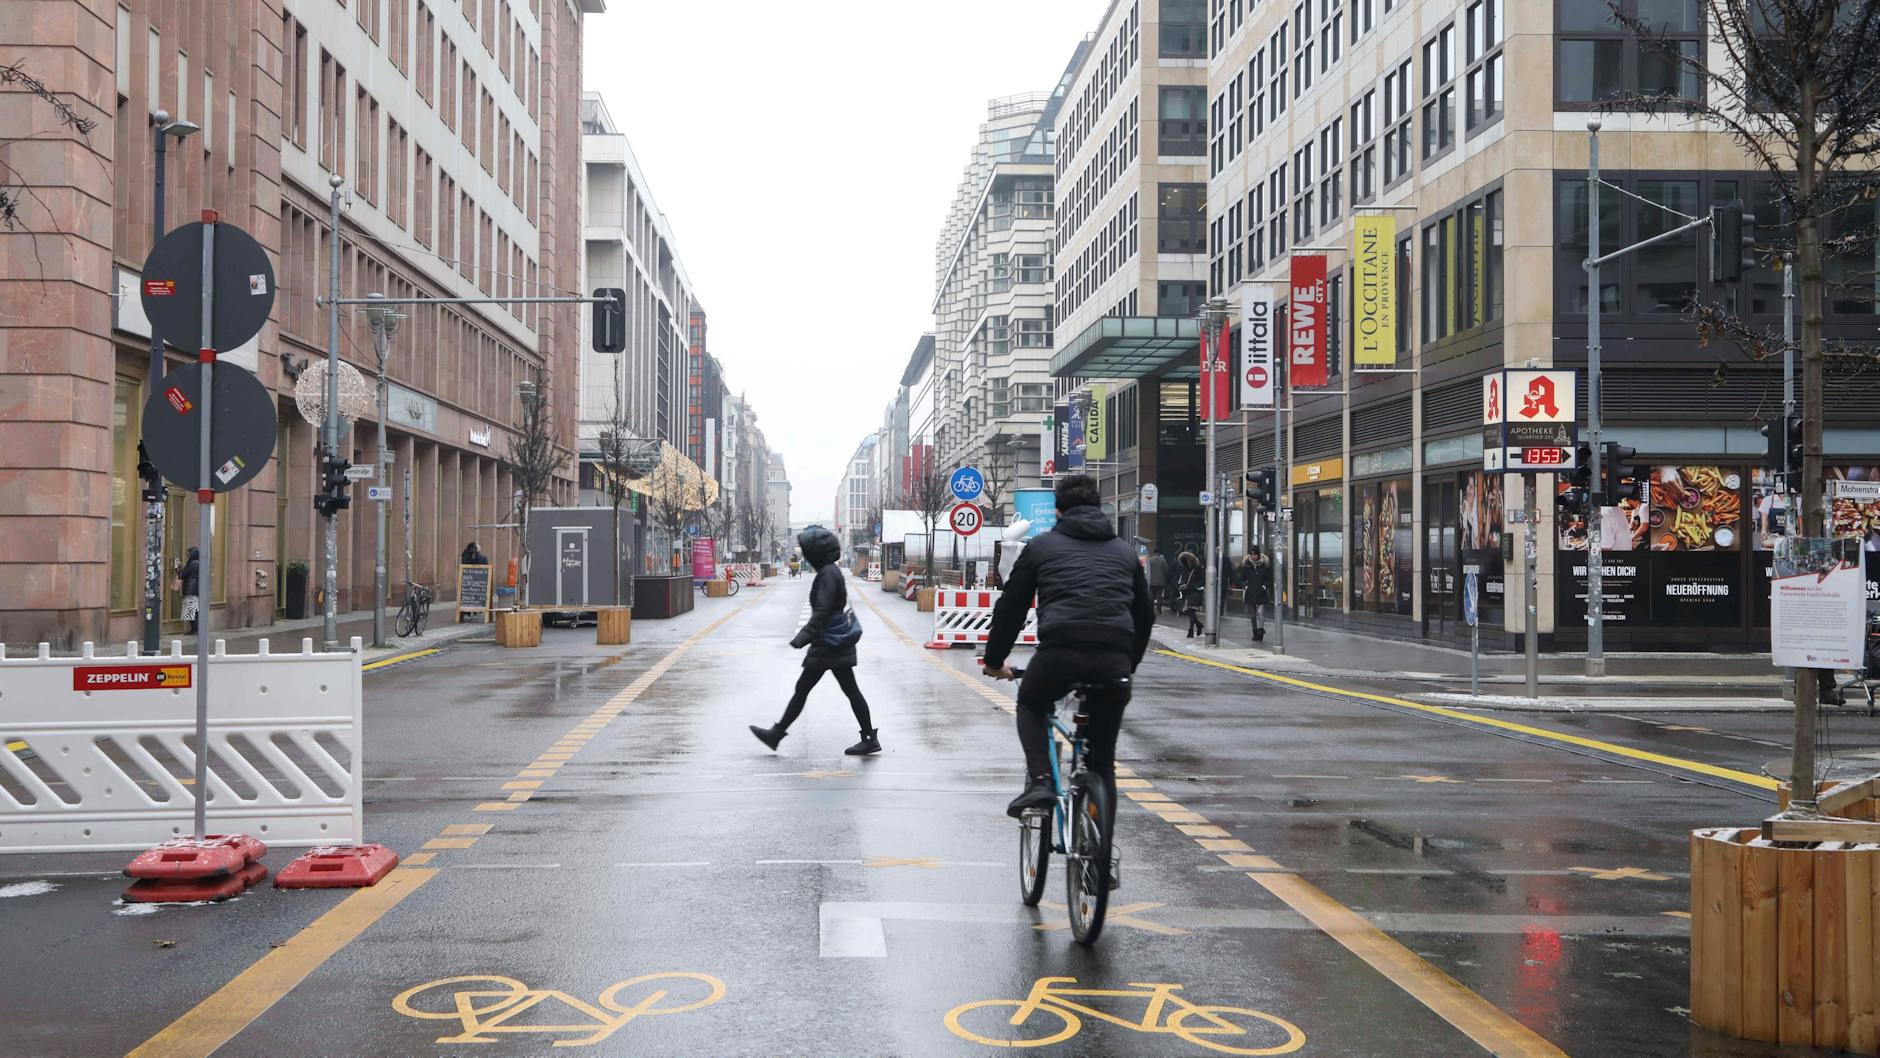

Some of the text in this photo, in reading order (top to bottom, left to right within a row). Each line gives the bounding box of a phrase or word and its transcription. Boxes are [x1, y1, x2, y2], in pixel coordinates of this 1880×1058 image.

[1360, 228, 1377, 351] L'OCCITANE
[1293, 286, 1315, 365] REWE
[1382, 314, 1389, 328] EN
[1248, 301, 1268, 364] iittala
[1089, 400, 1099, 444] CALIDA
[1510, 427, 1554, 435] APOTHEKE
[1840, 484, 1879, 494] Mohrenstra
[957, 512, 975, 526] 20
[1572, 565, 1636, 577] WIR HEN DICH!
[1666, 582, 1729, 596] NEUERÖFFNUNG
[87, 673, 149, 684] ZEPPELIN
